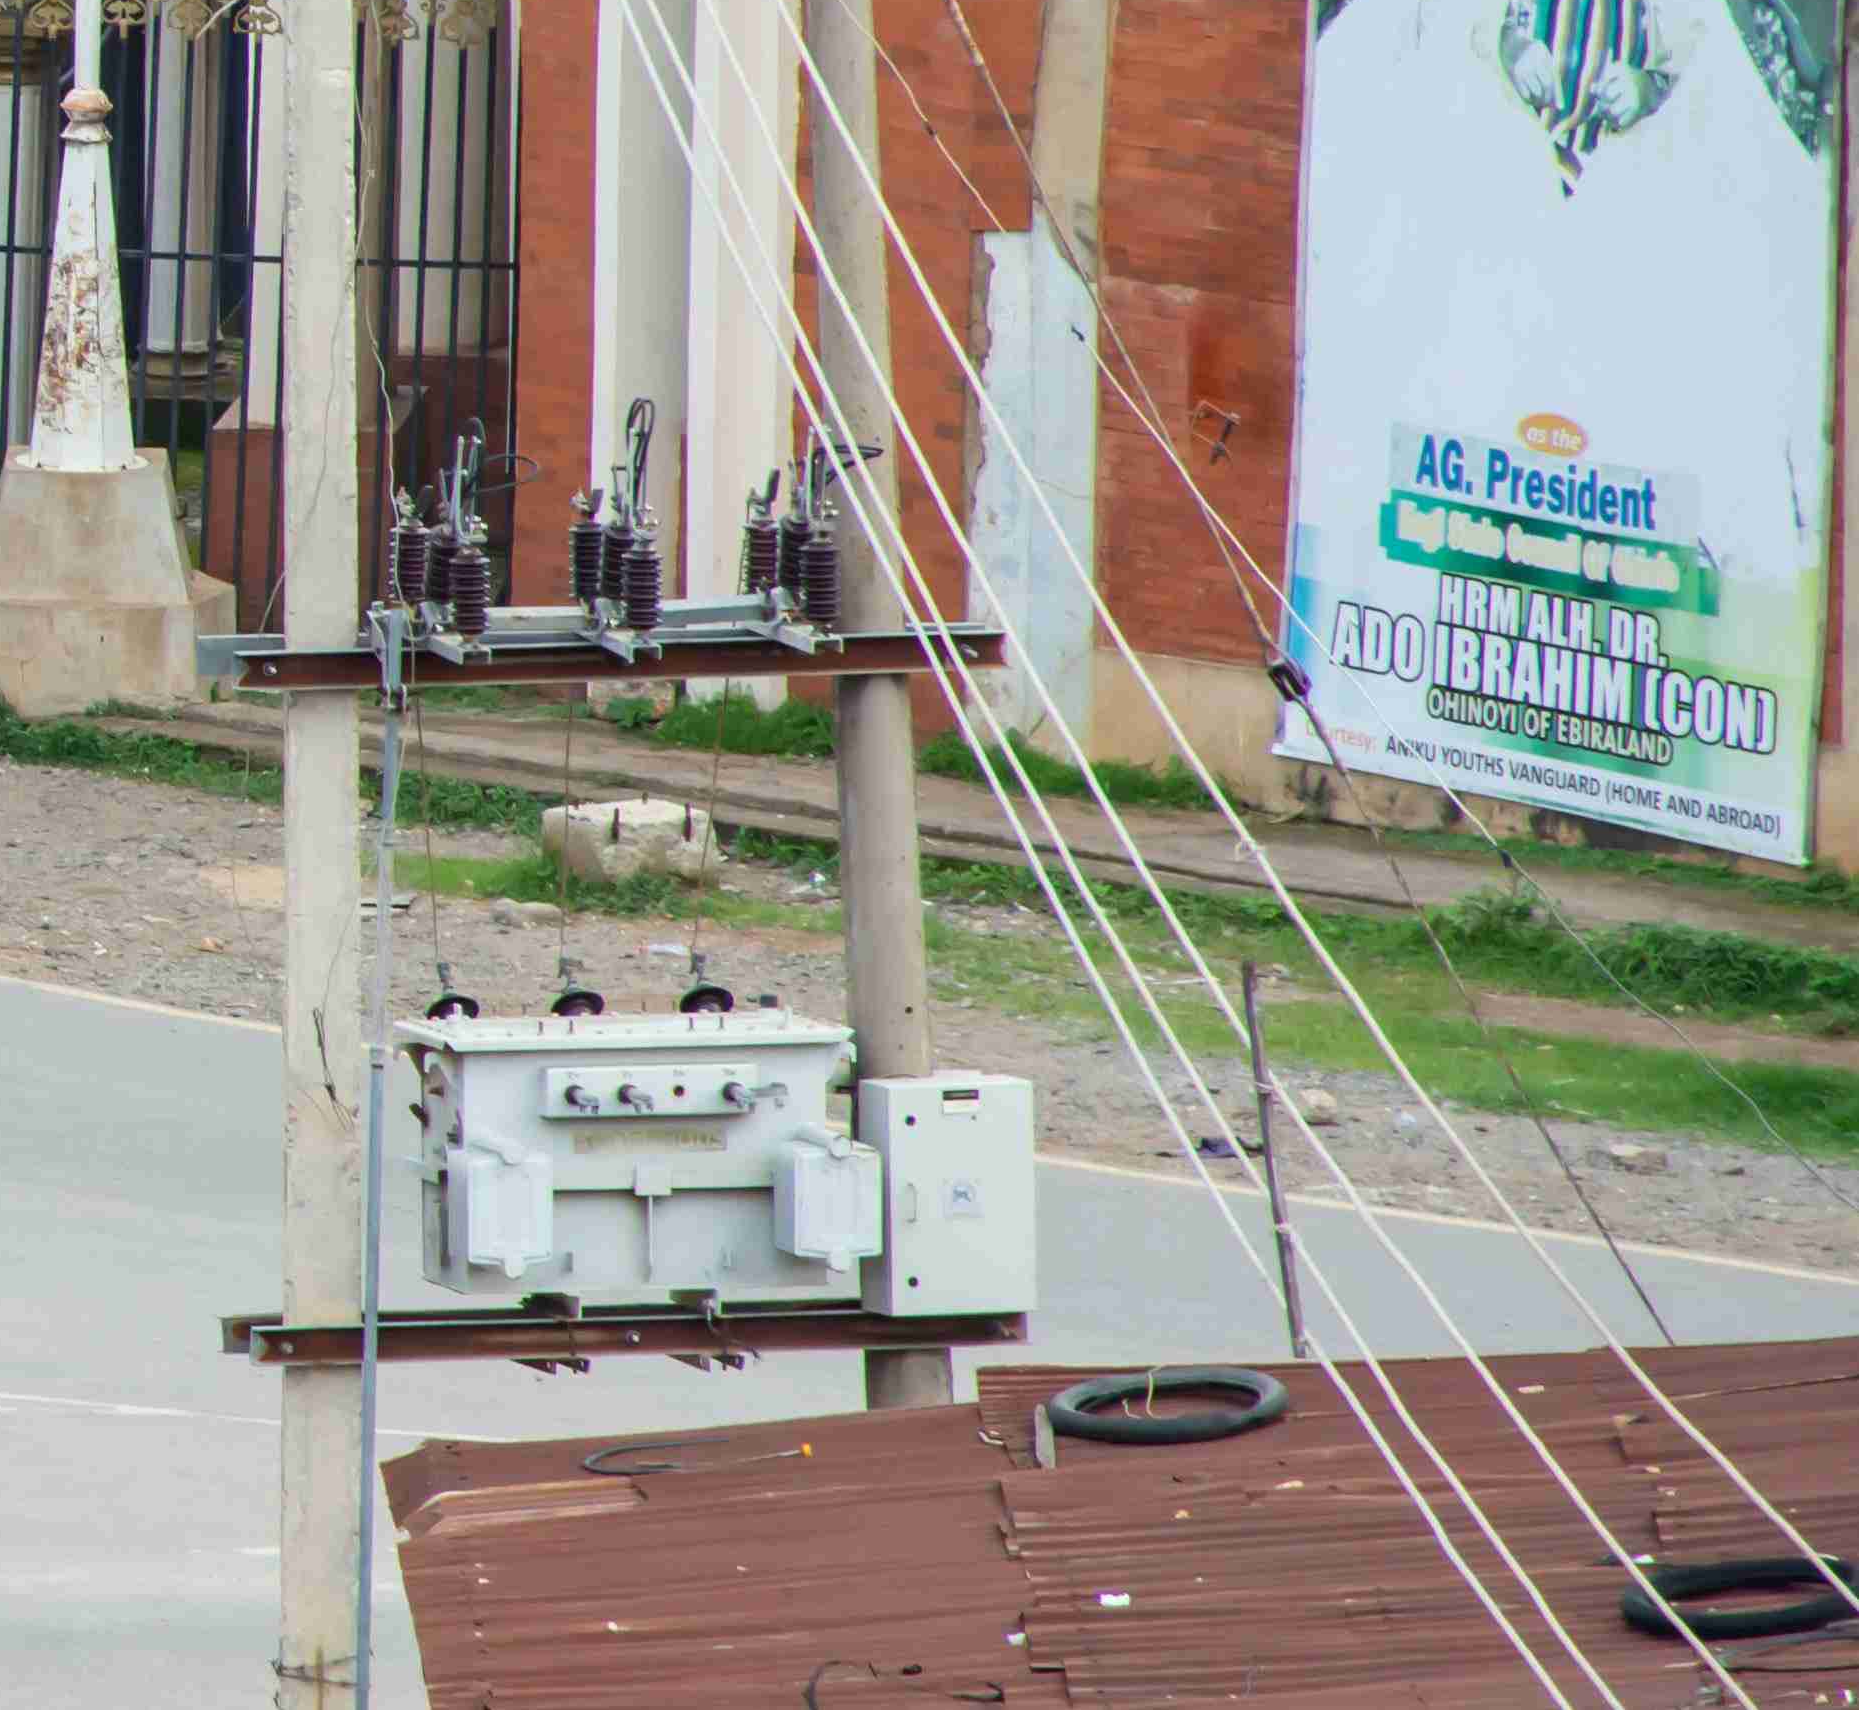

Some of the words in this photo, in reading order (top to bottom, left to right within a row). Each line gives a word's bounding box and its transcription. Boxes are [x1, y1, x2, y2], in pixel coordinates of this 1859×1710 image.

[1416, 434, 1474, 496] AG.
[1486, 448, 1656, 531] President
[1552, 428, 1581, 451] the
[1331, 602, 1424, 682] ADO
[1434, 625, 1633, 723] IBRAHIM
[1439, 573, 1521, 640] HRM
[1527, 589, 1601, 652] ALH.
[1607, 606, 1667, 667] DR.
[1427, 688, 1518, 737] OHINOYI
[1523, 708, 1552, 741] OF
[1557, 712, 1675, 766] EBIRALAND
[1441, 748, 1505, 778] YOUTHS
[1509, 762, 1601, 798] VANGUARD
[1605, 779, 1662, 811] (HOME
[1667, 794, 1702, 819] AND
[1706, 802, 1782, 839] ABROAD)
